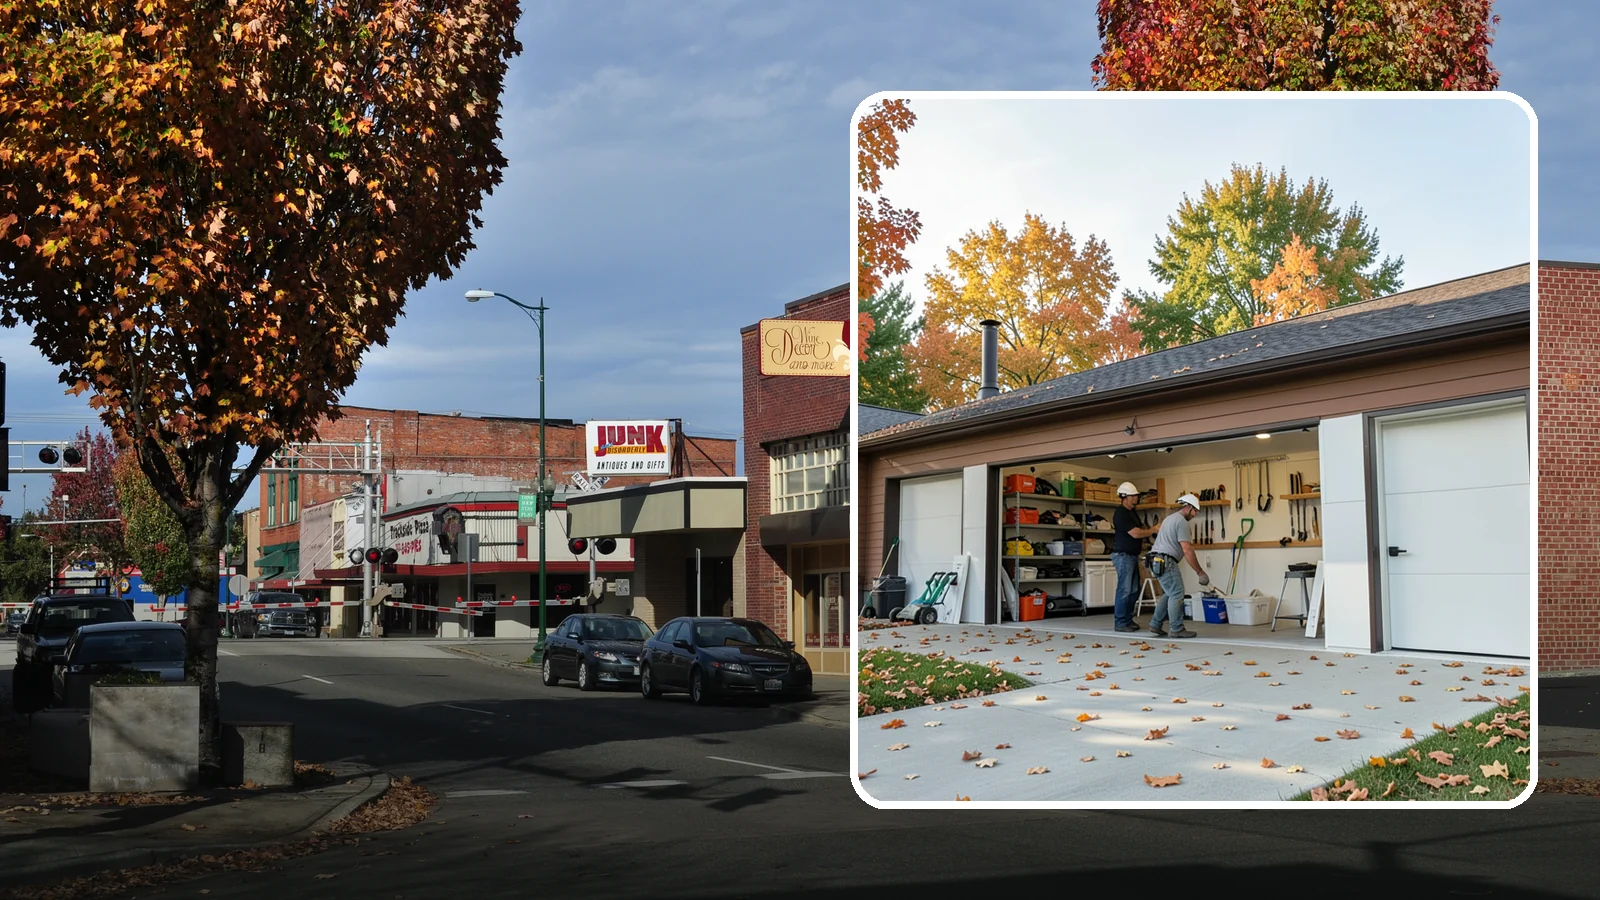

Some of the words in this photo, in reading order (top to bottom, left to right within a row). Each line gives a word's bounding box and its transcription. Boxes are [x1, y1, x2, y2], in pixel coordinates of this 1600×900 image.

[595, 425, 665, 457] JUNK
[607, 446, 646, 454] DISORDERLY
[597, 461, 628, 470] ANTIQUES
[631, 461, 643, 470] AND
[647, 460, 665, 469] GIFTS
[573, 473, 587, 491] RAIL
[390, 521, 413, 539] Trackside
[415, 519, 428, 534] Pizza
